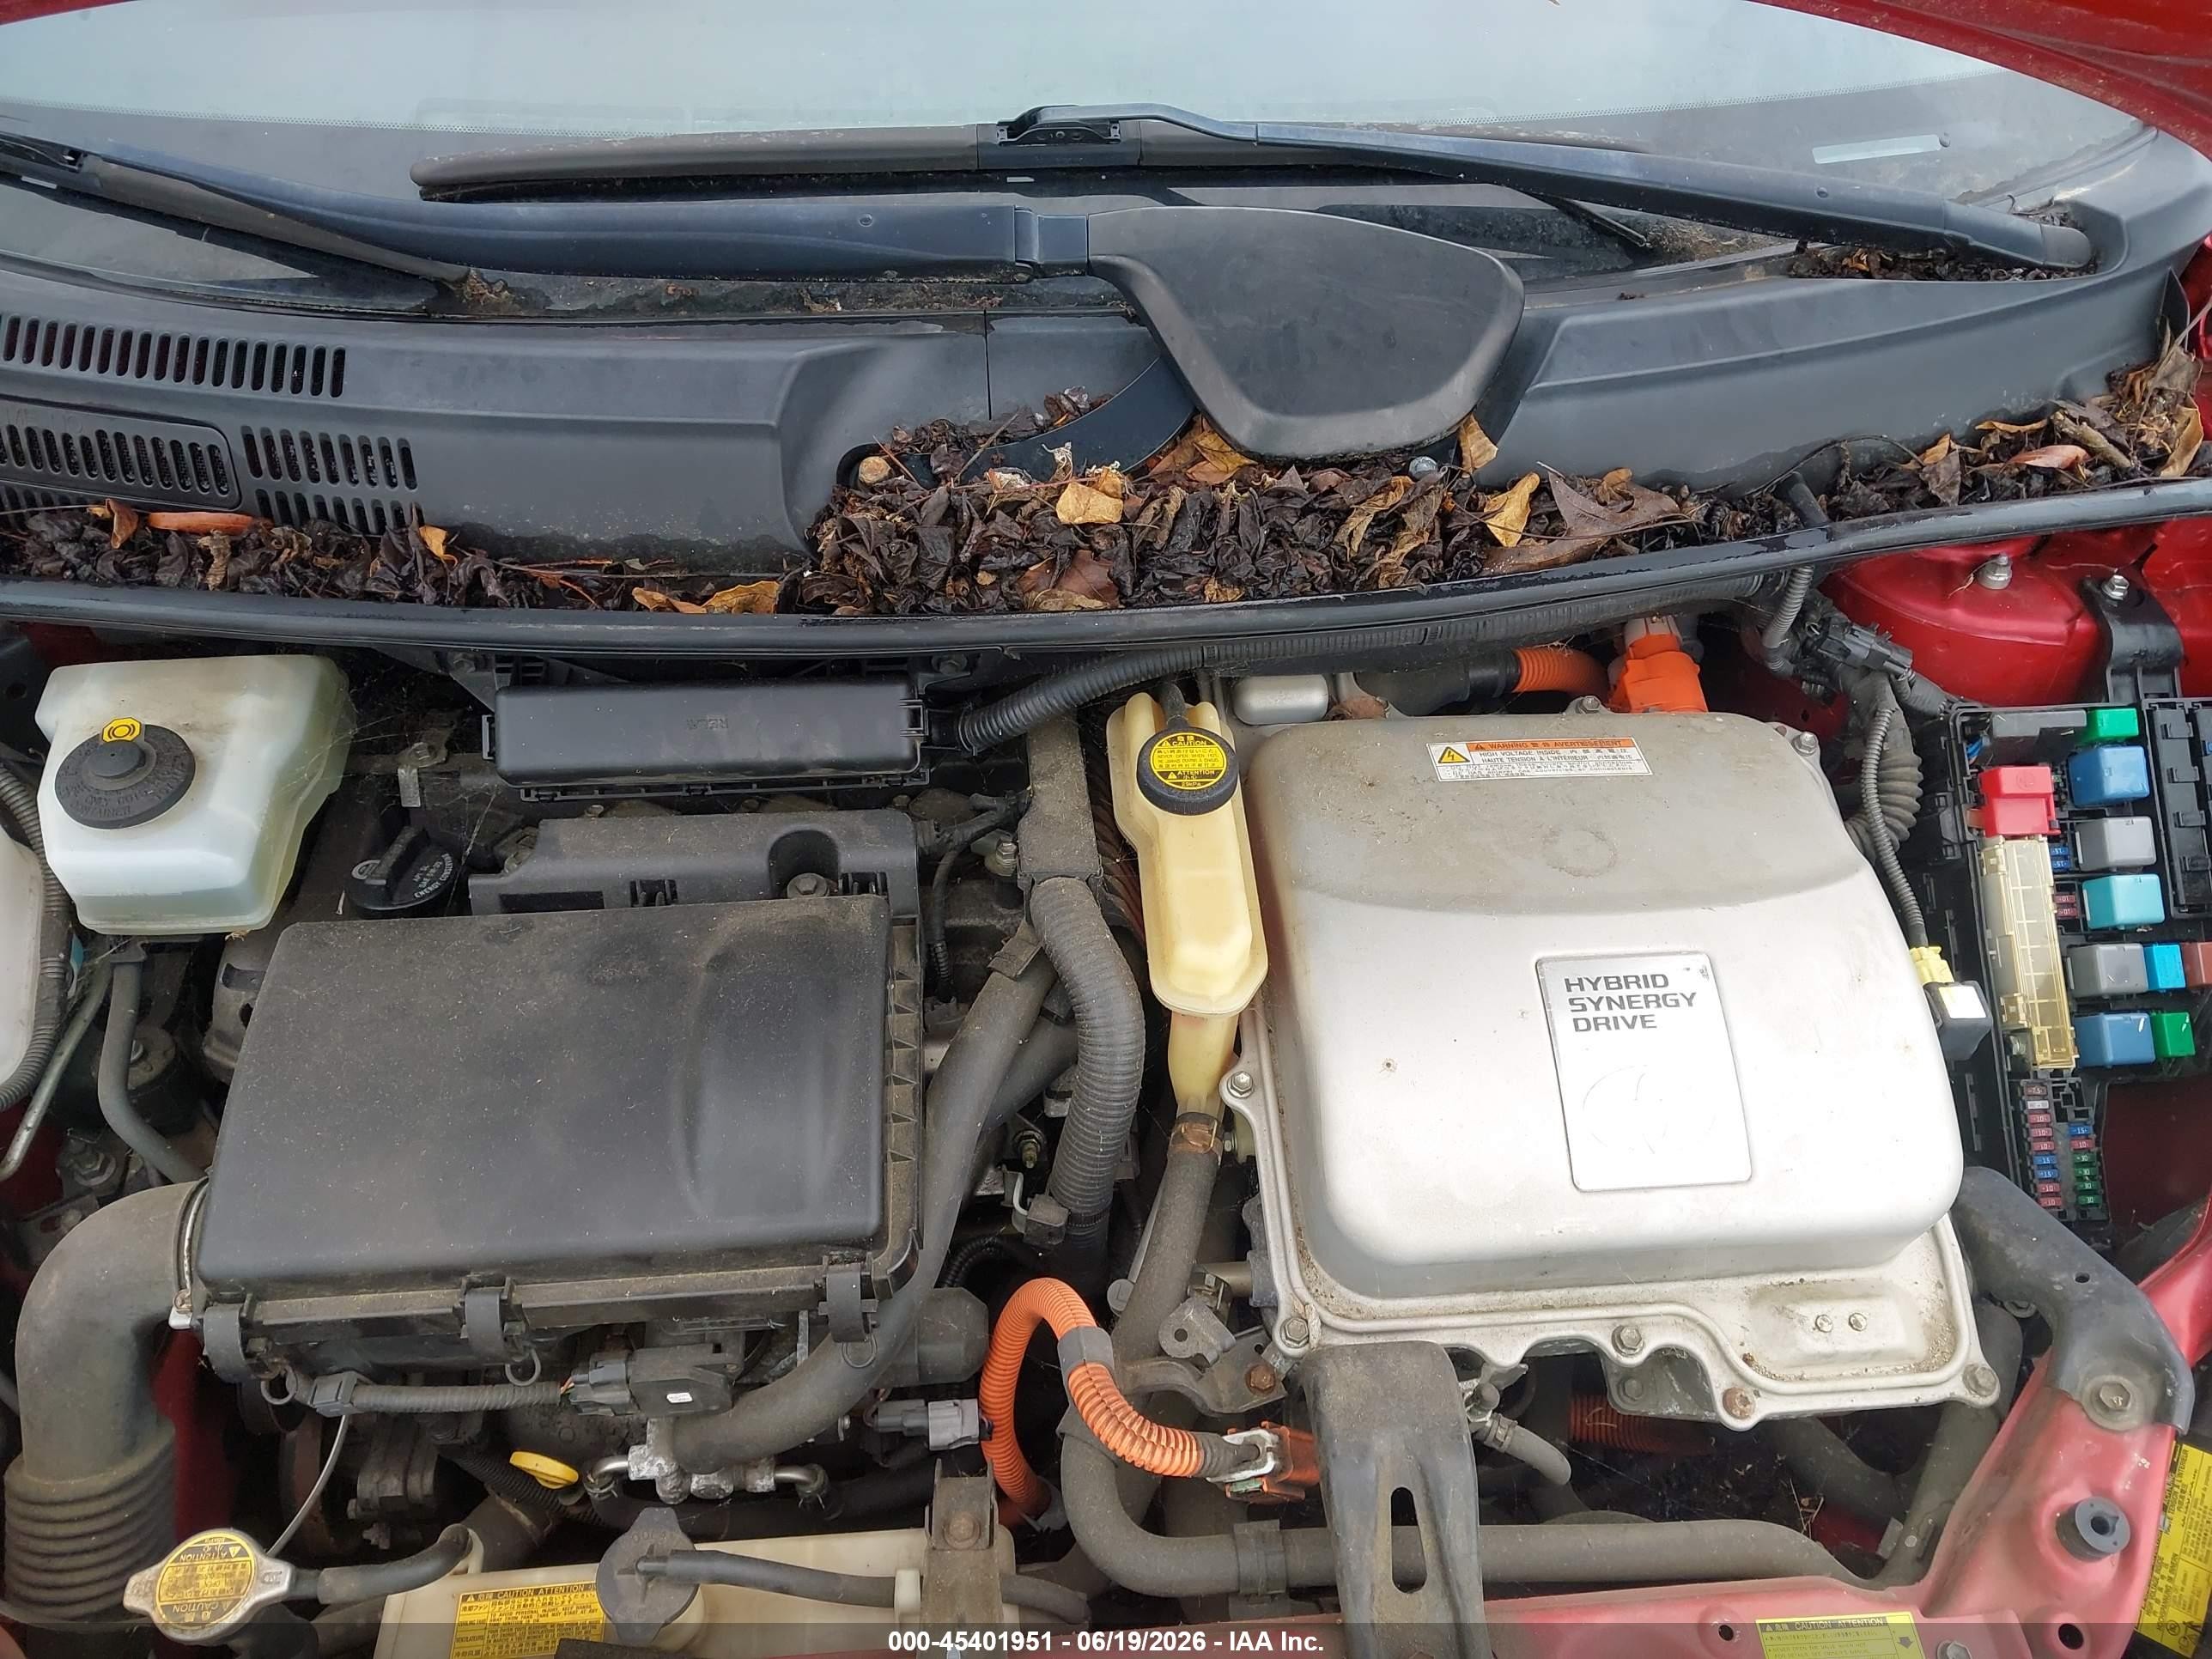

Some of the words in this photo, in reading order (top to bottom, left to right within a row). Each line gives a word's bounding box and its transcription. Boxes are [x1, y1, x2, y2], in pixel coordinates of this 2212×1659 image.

[1488, 741, 1528, 750] WARNING
[1565, 974, 1669, 993] HYBRID
[1568, 992, 1697, 1012] SYNERGY
[1572, 1014, 1657, 1033] DRIVE
[179, 1552, 227, 1562] ATTENTION
[498, 1589, 534, 1598] CAUTION
[538, 1584, 584, 1595] ATTENTION
[173, 1602, 218, 1614] CAUTION
[1795, 1620, 1832, 1631] CAUTION
[1838, 1618, 1883, 1628] ATTENTION
